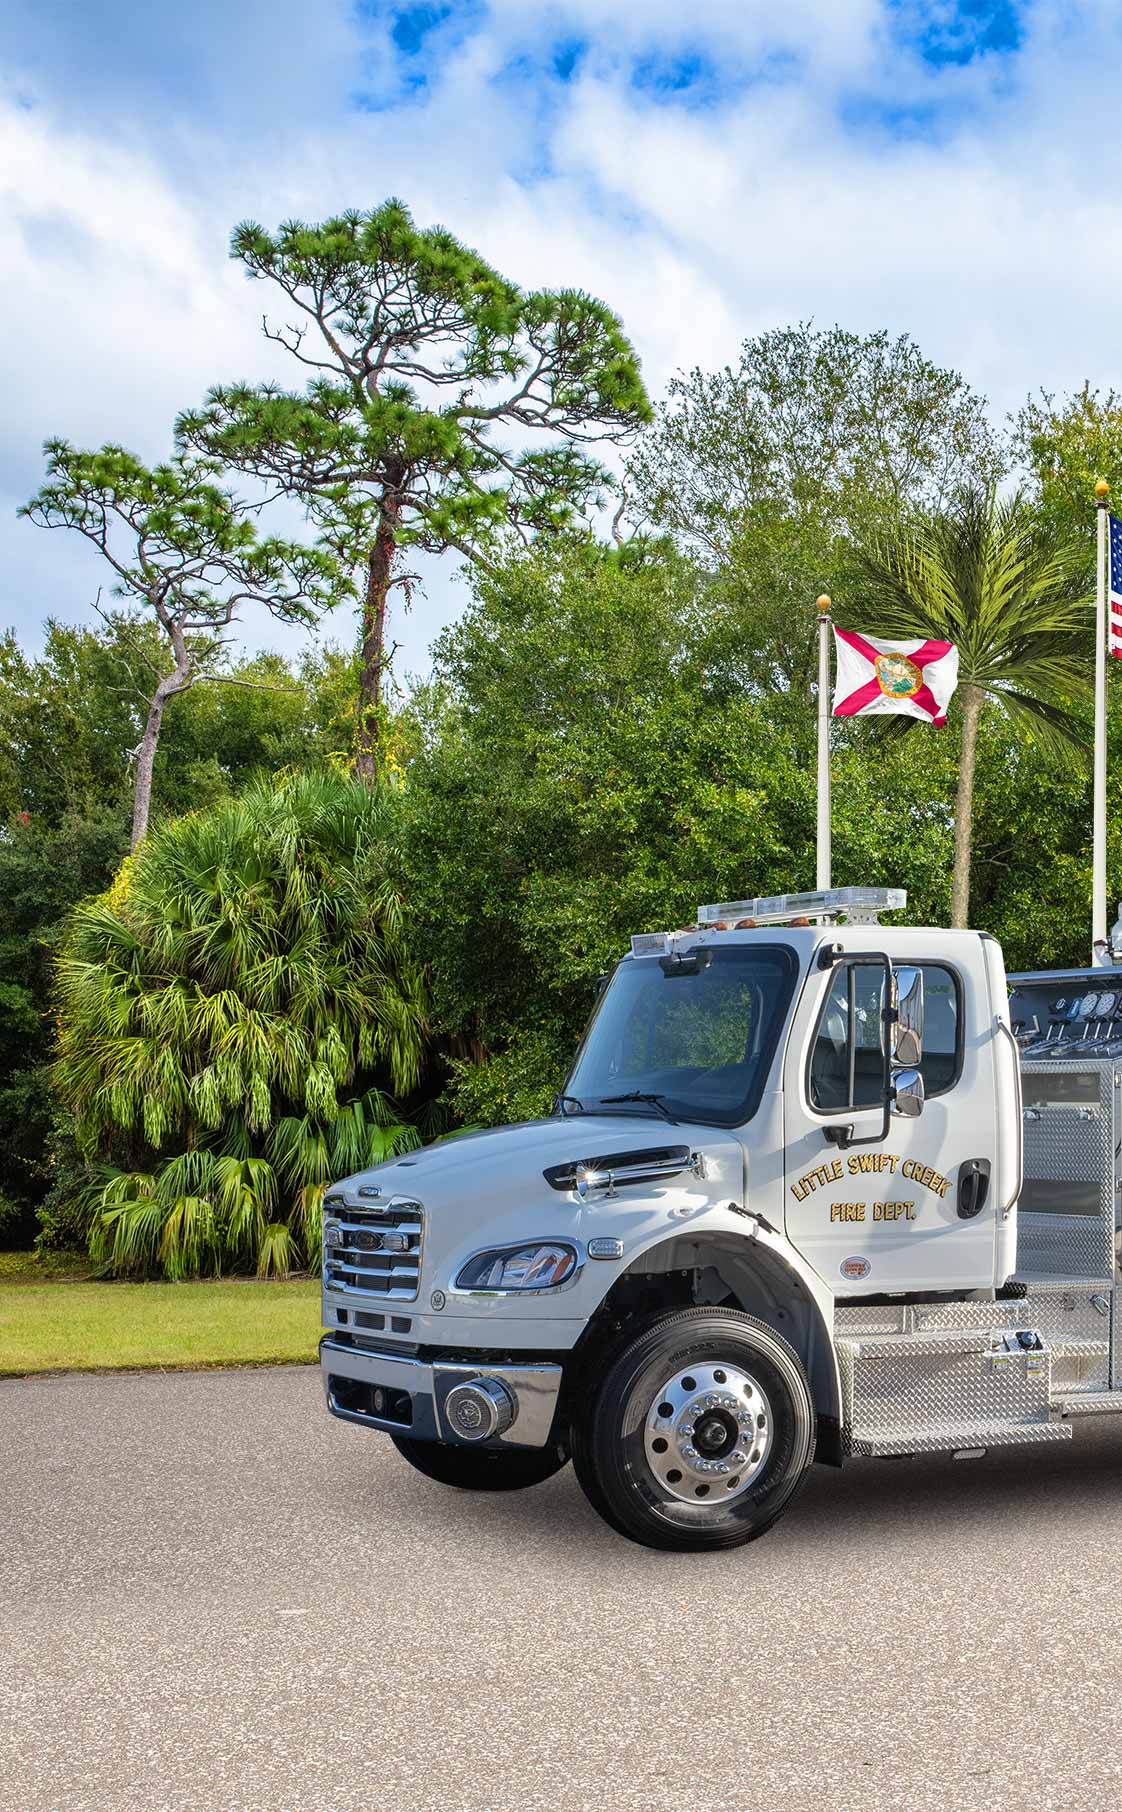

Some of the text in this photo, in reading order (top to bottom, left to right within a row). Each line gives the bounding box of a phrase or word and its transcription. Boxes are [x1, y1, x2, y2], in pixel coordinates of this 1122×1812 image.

[790, 1153, 953, 1202] LITTLE SWIFT CREEK
[830, 1201, 917, 1222] FIRE DEPT.
